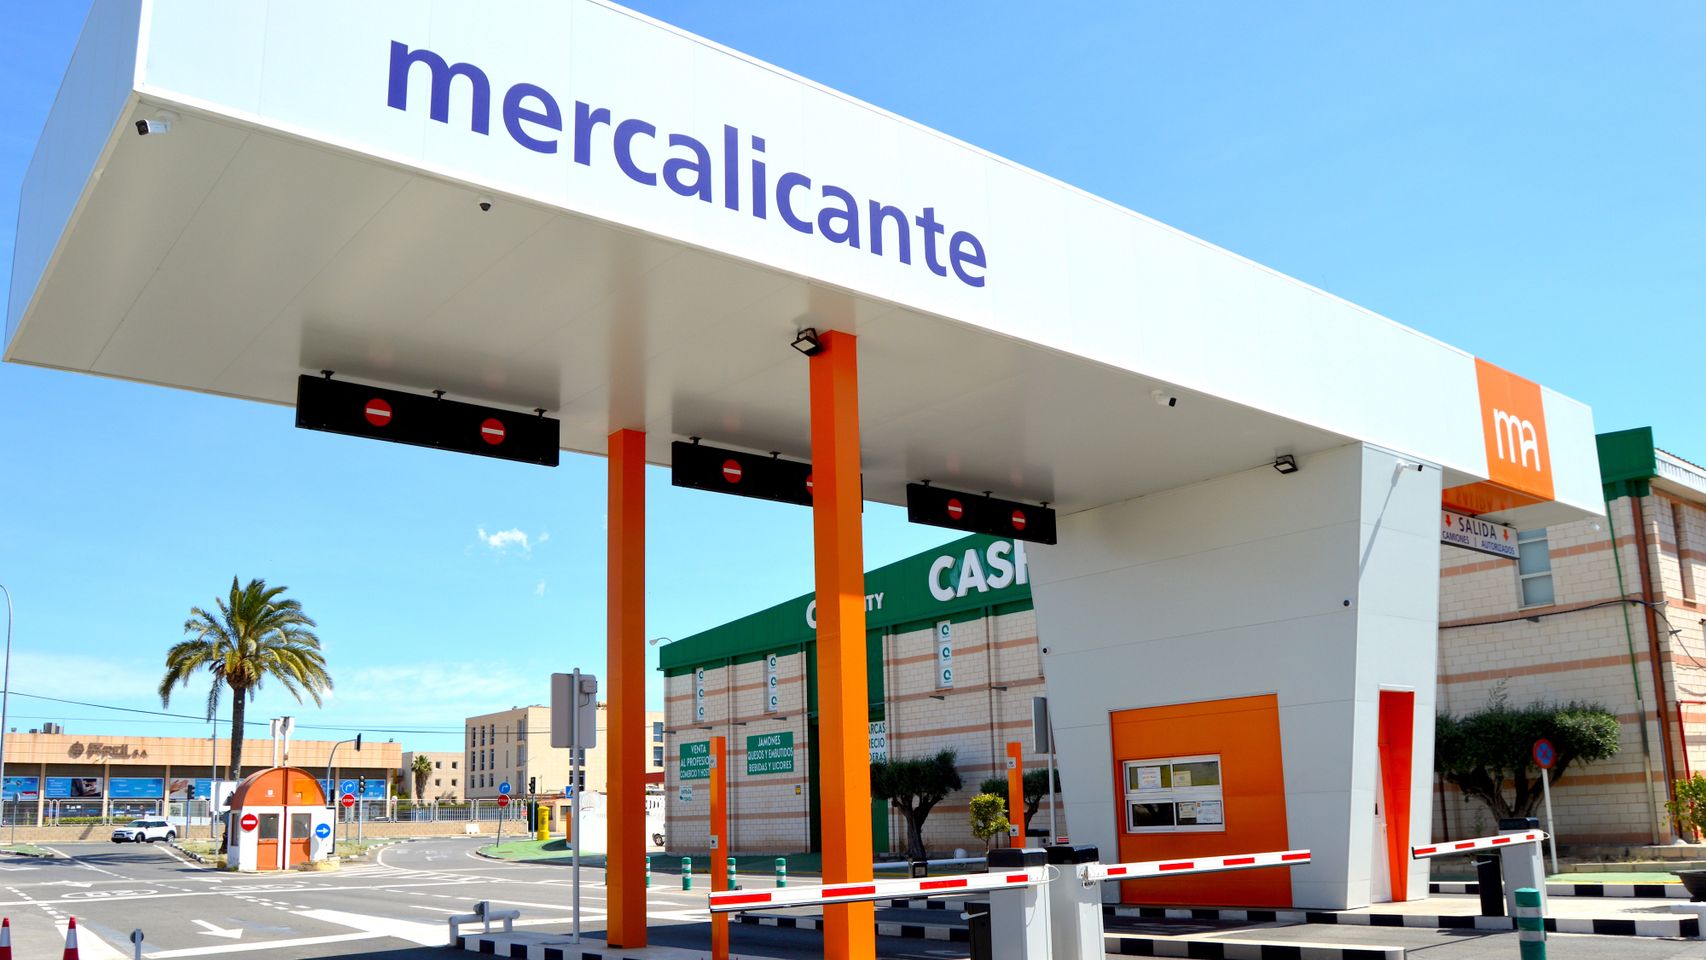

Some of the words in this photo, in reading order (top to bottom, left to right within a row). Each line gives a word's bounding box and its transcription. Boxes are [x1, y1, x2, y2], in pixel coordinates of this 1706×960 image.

[387, 40, 987, 288] mercalicante
[1458, 517, 1497, 540] SALIDA
[1442, 530, 1470, 545] CAMIONES
[1481, 540, 1516, 555] AUTORIZADOS
[758, 735, 781, 747] JAMONES
[690, 744, 707, 754] VENTA
[748, 750, 764, 760] QUESOS
[768, 747, 793, 759] EMBUTIDOS
[681, 758, 686, 767] AL
[749, 762, 768, 772] BEBIDAS
[772, 760, 792, 770] LICORES
